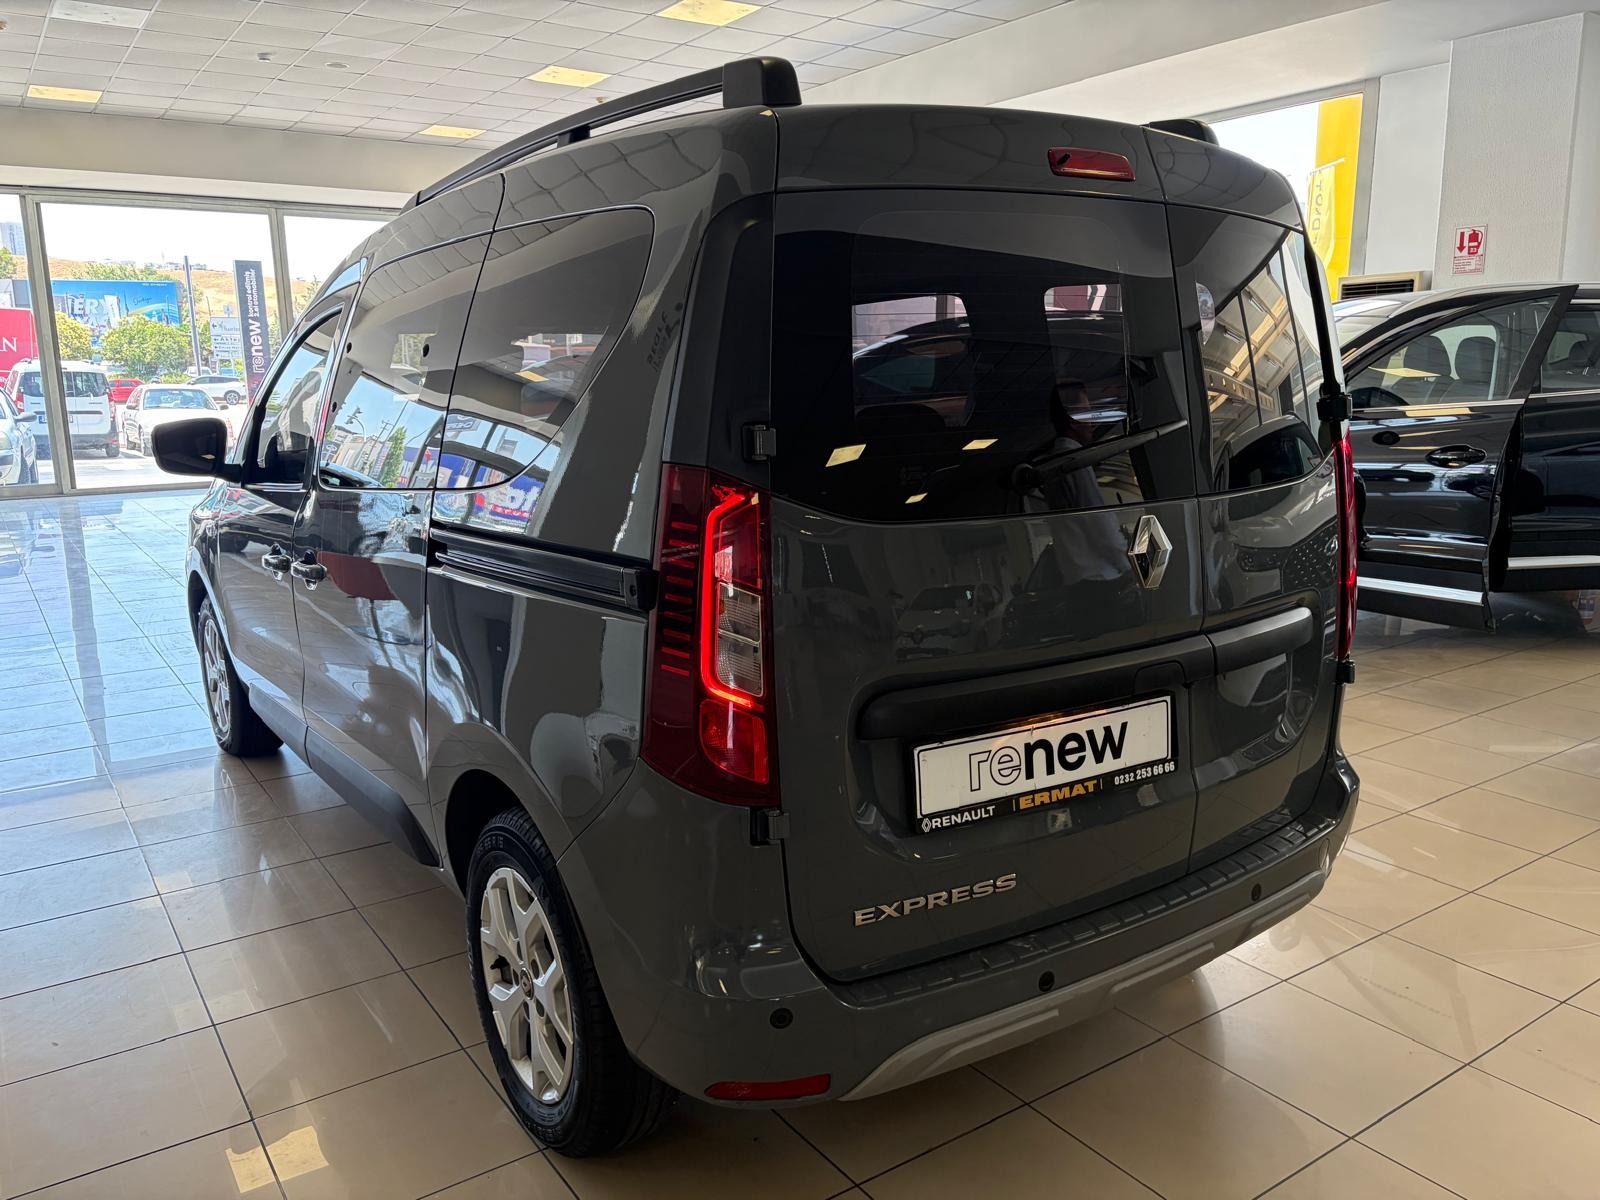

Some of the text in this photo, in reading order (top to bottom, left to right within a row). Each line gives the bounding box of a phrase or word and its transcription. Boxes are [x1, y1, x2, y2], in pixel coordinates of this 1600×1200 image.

[249, 319, 265, 373] renew
[969, 721, 1128, 792] renew
[1114, 761, 1175, 785] 0232 253 66 66
[1019, 779, 1098, 809] ERMAT
[931, 805, 996, 829] RENAULT
[853, 873, 1017, 927] EXPRESS
